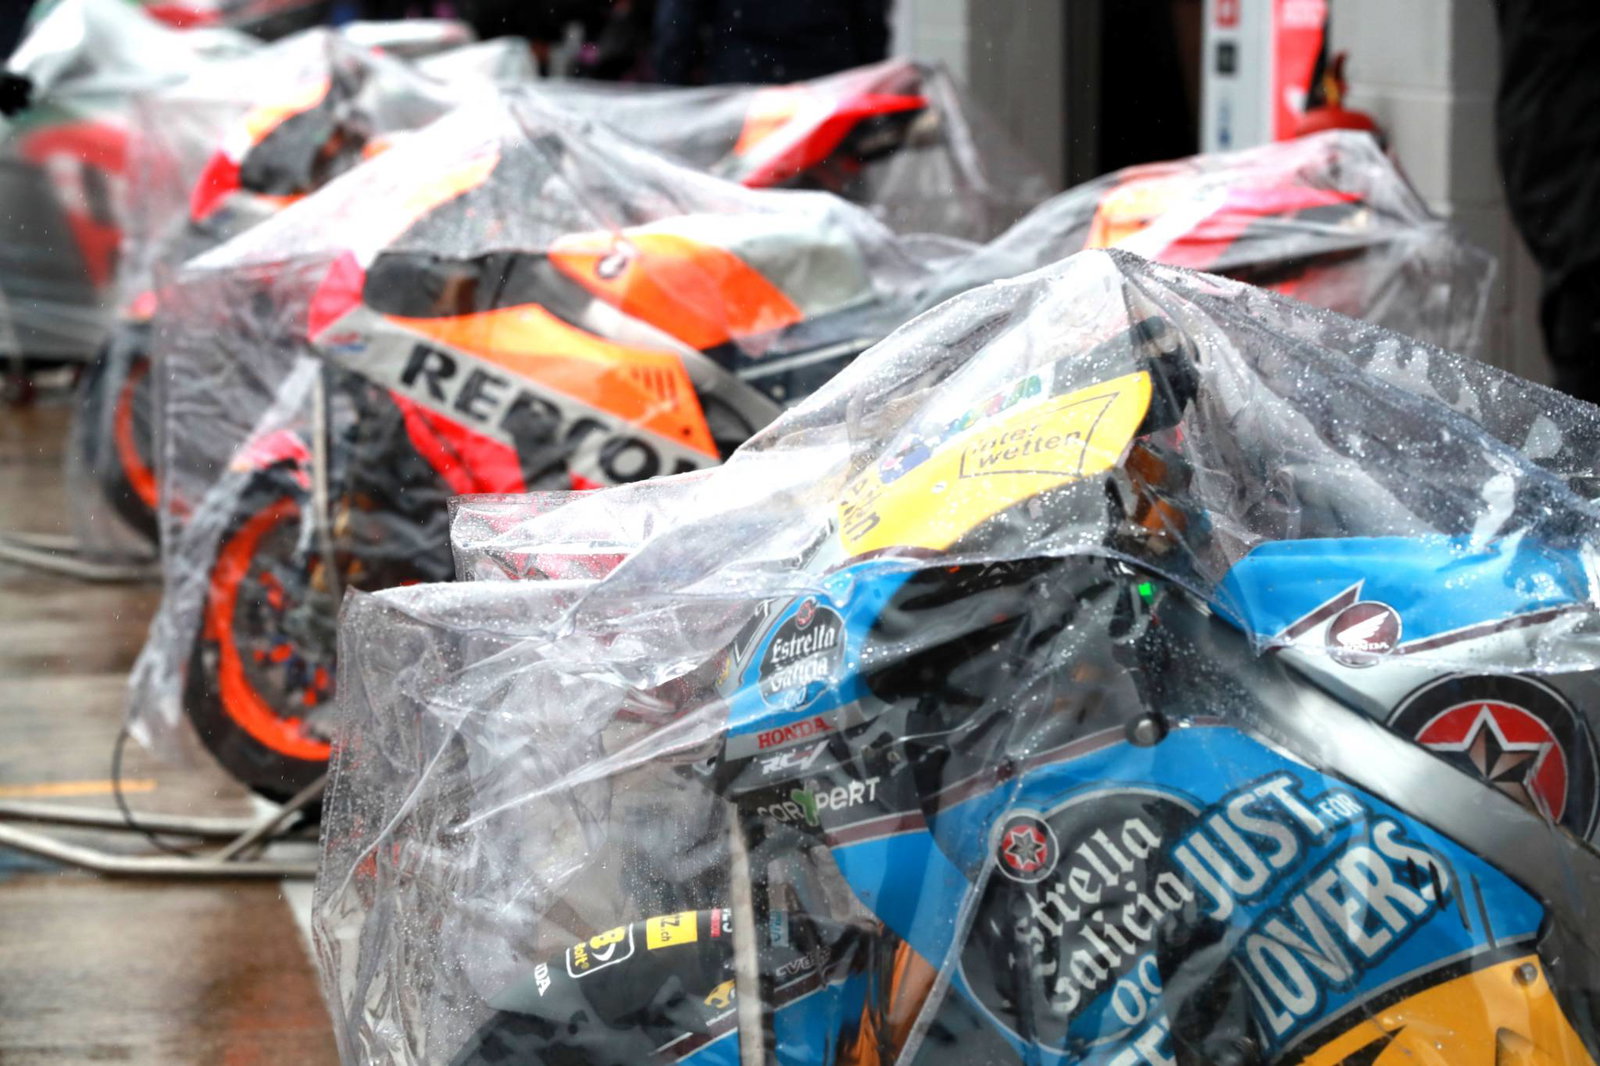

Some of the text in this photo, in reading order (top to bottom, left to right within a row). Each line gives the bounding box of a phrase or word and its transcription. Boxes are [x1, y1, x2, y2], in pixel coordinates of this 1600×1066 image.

[770, 624, 836, 664] Estrella
[757, 716, 834, 750] HONDA
[1174, 776, 1364, 922] JUST FOR
[1232, 820, 1450, 1038] LOVERS
